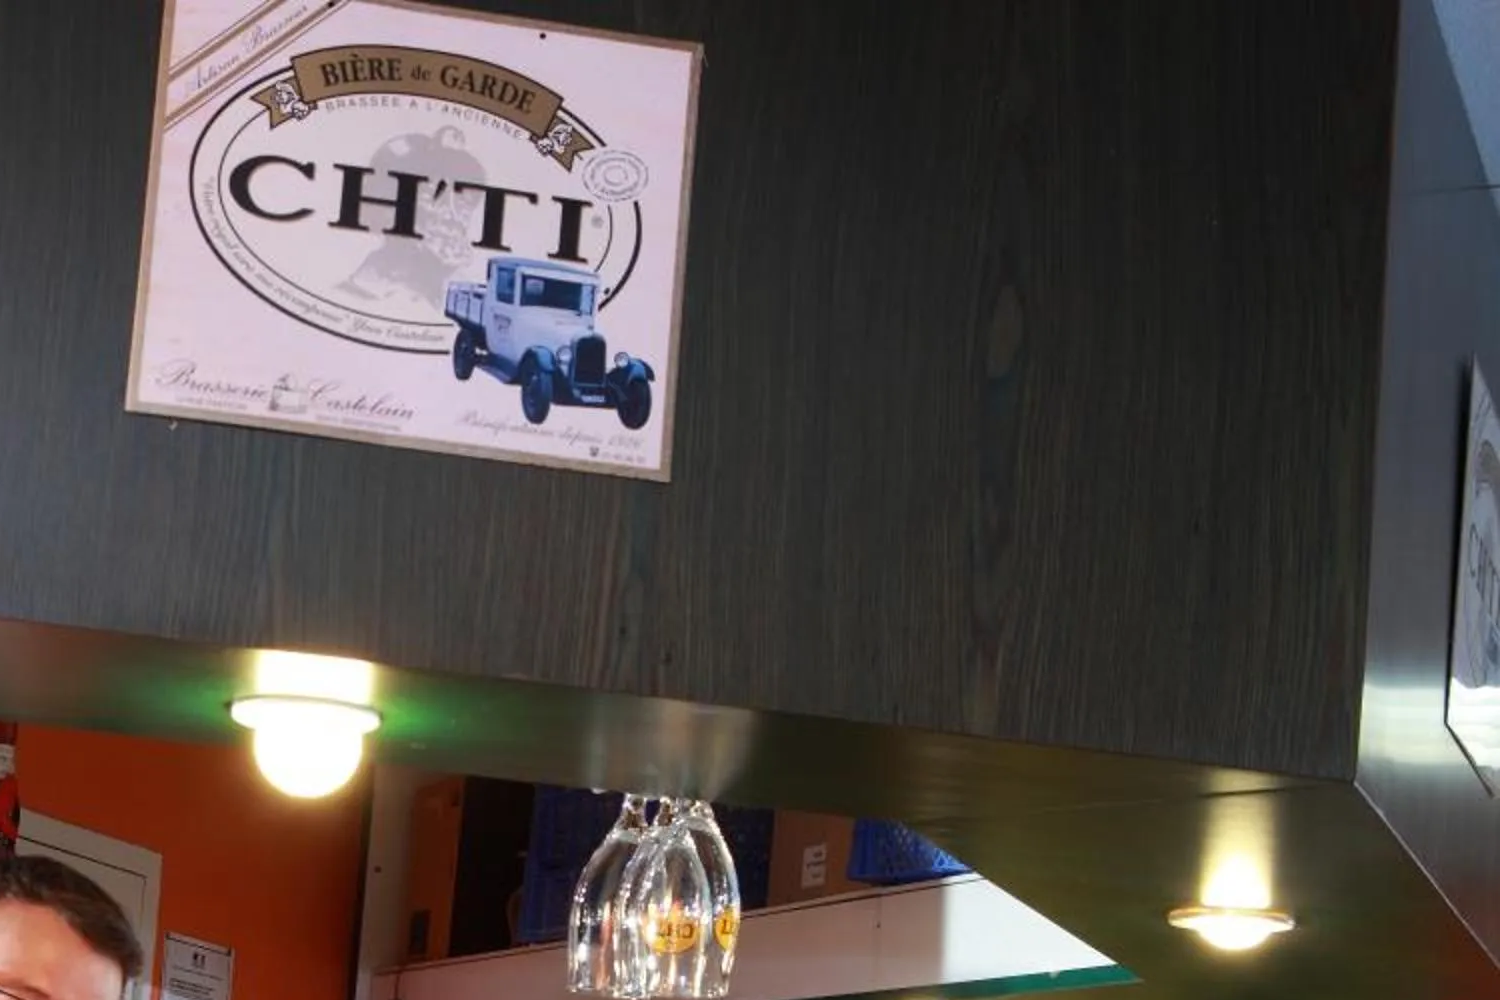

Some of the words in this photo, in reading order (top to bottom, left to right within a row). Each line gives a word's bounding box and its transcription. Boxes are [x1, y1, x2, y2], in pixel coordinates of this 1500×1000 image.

[320, 54, 403, 87] BIÈRE
[410, 64, 431, 81] de
[440, 65, 537, 114] GARDE
[230, 154, 593, 263] CH'TI
